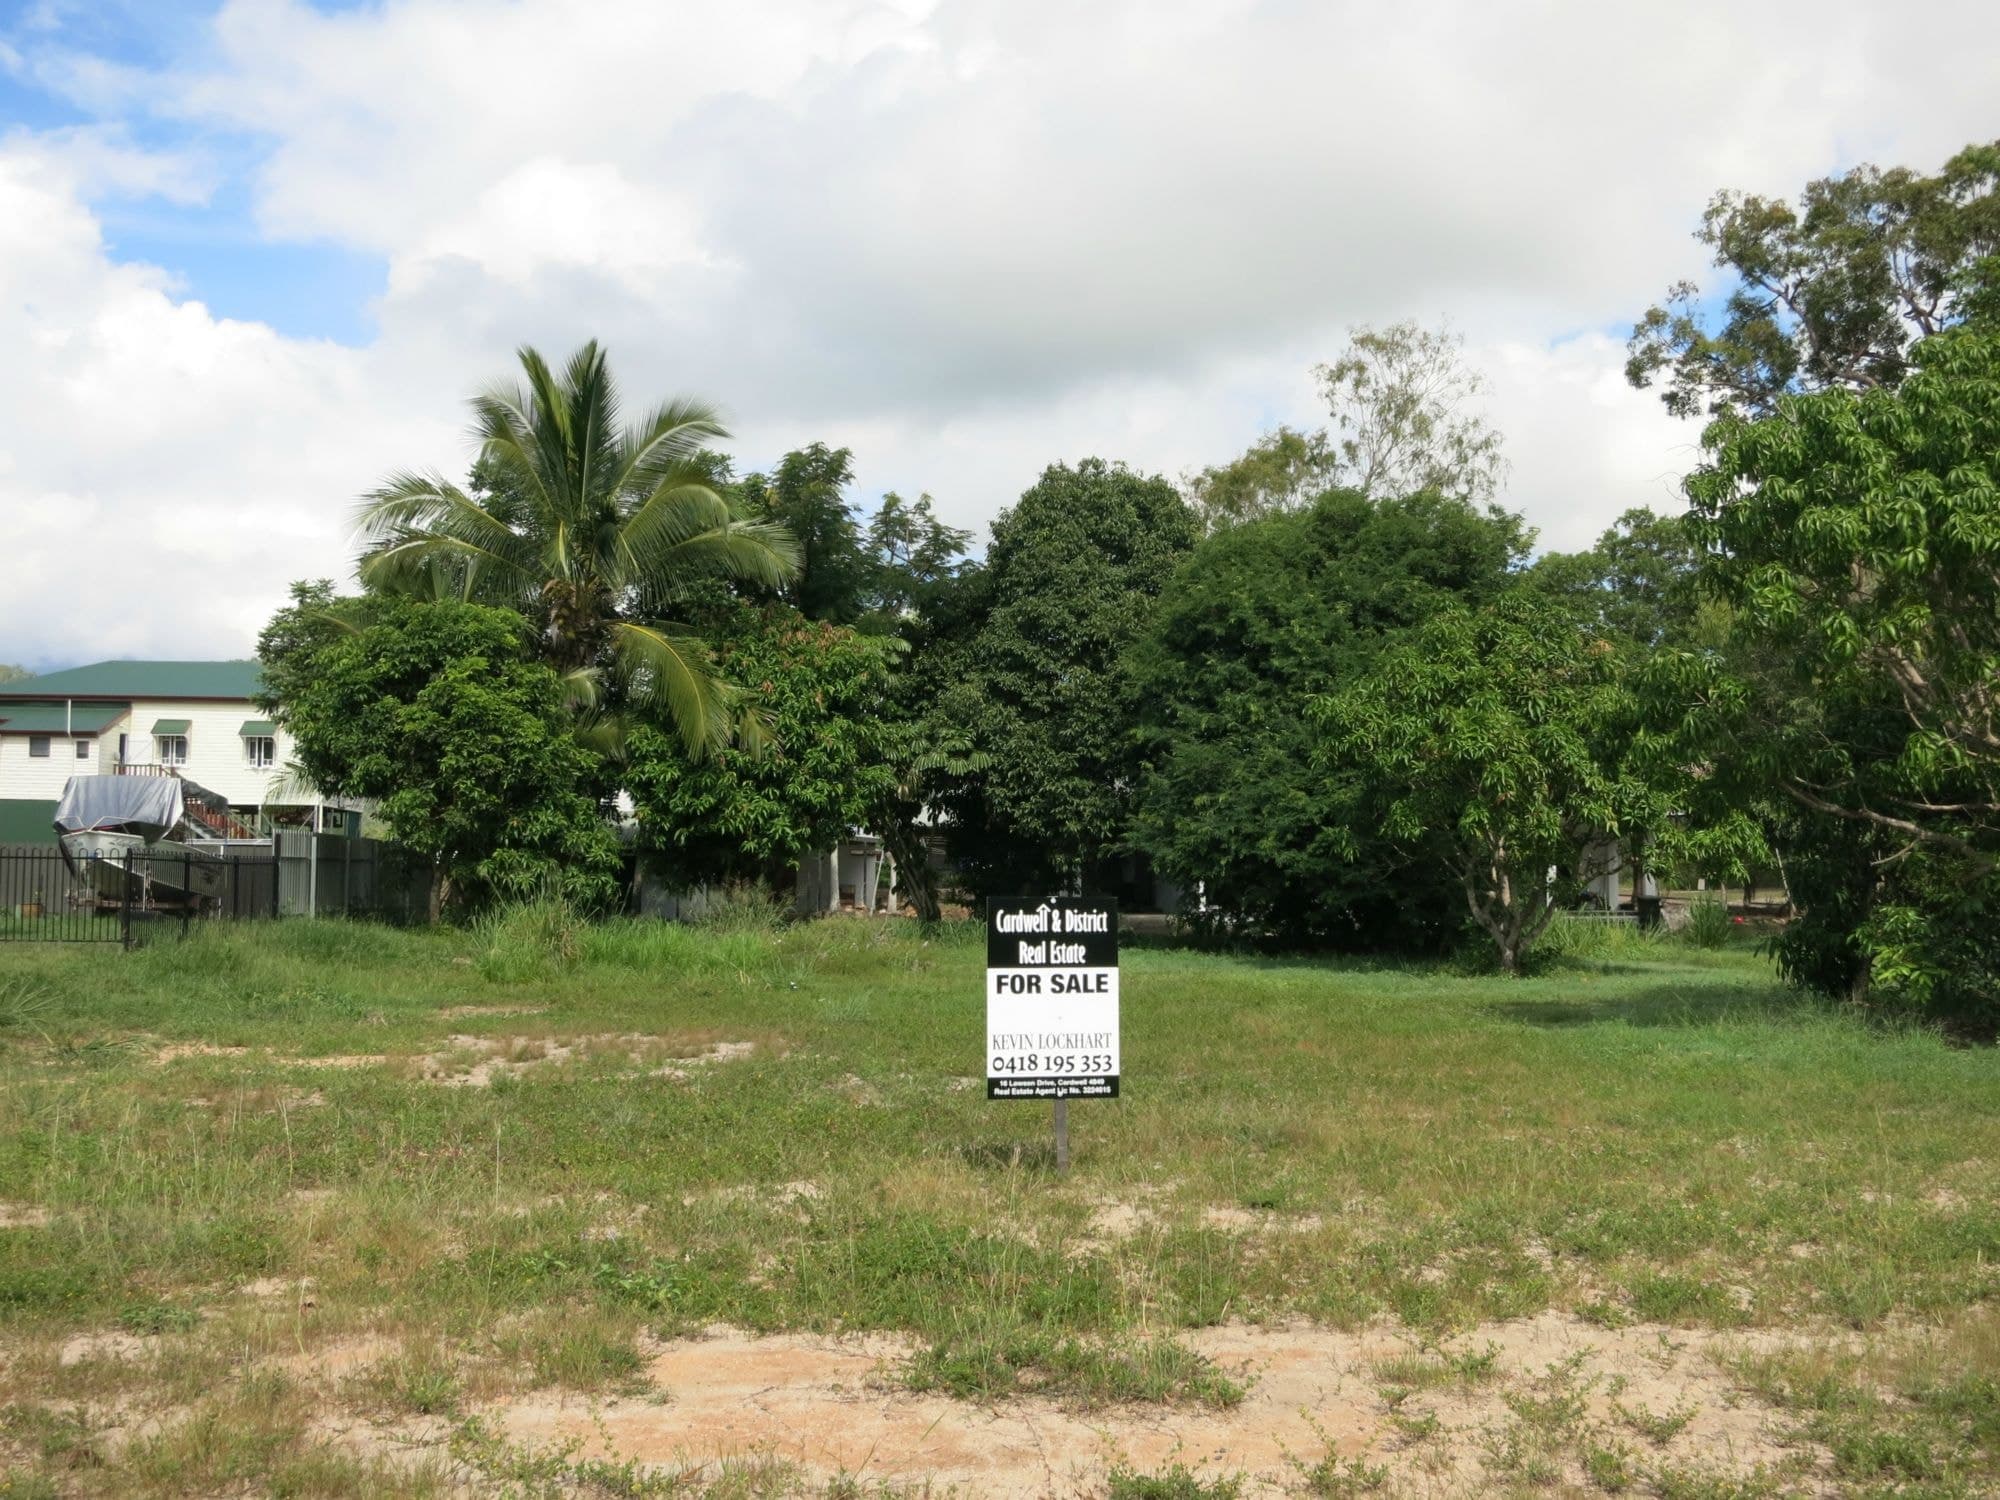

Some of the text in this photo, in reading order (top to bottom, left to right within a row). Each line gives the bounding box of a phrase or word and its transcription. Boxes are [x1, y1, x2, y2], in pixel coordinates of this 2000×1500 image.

[996, 906, 1108, 932] Cardwell & District
[1019, 940, 1086, 964] Real Estate
[996, 973, 1109, 994] FOR SALE
[993, 1032, 1112, 1050] KEVIN LOCKHART
[993, 1054, 1112, 1074] 0418 195 353
